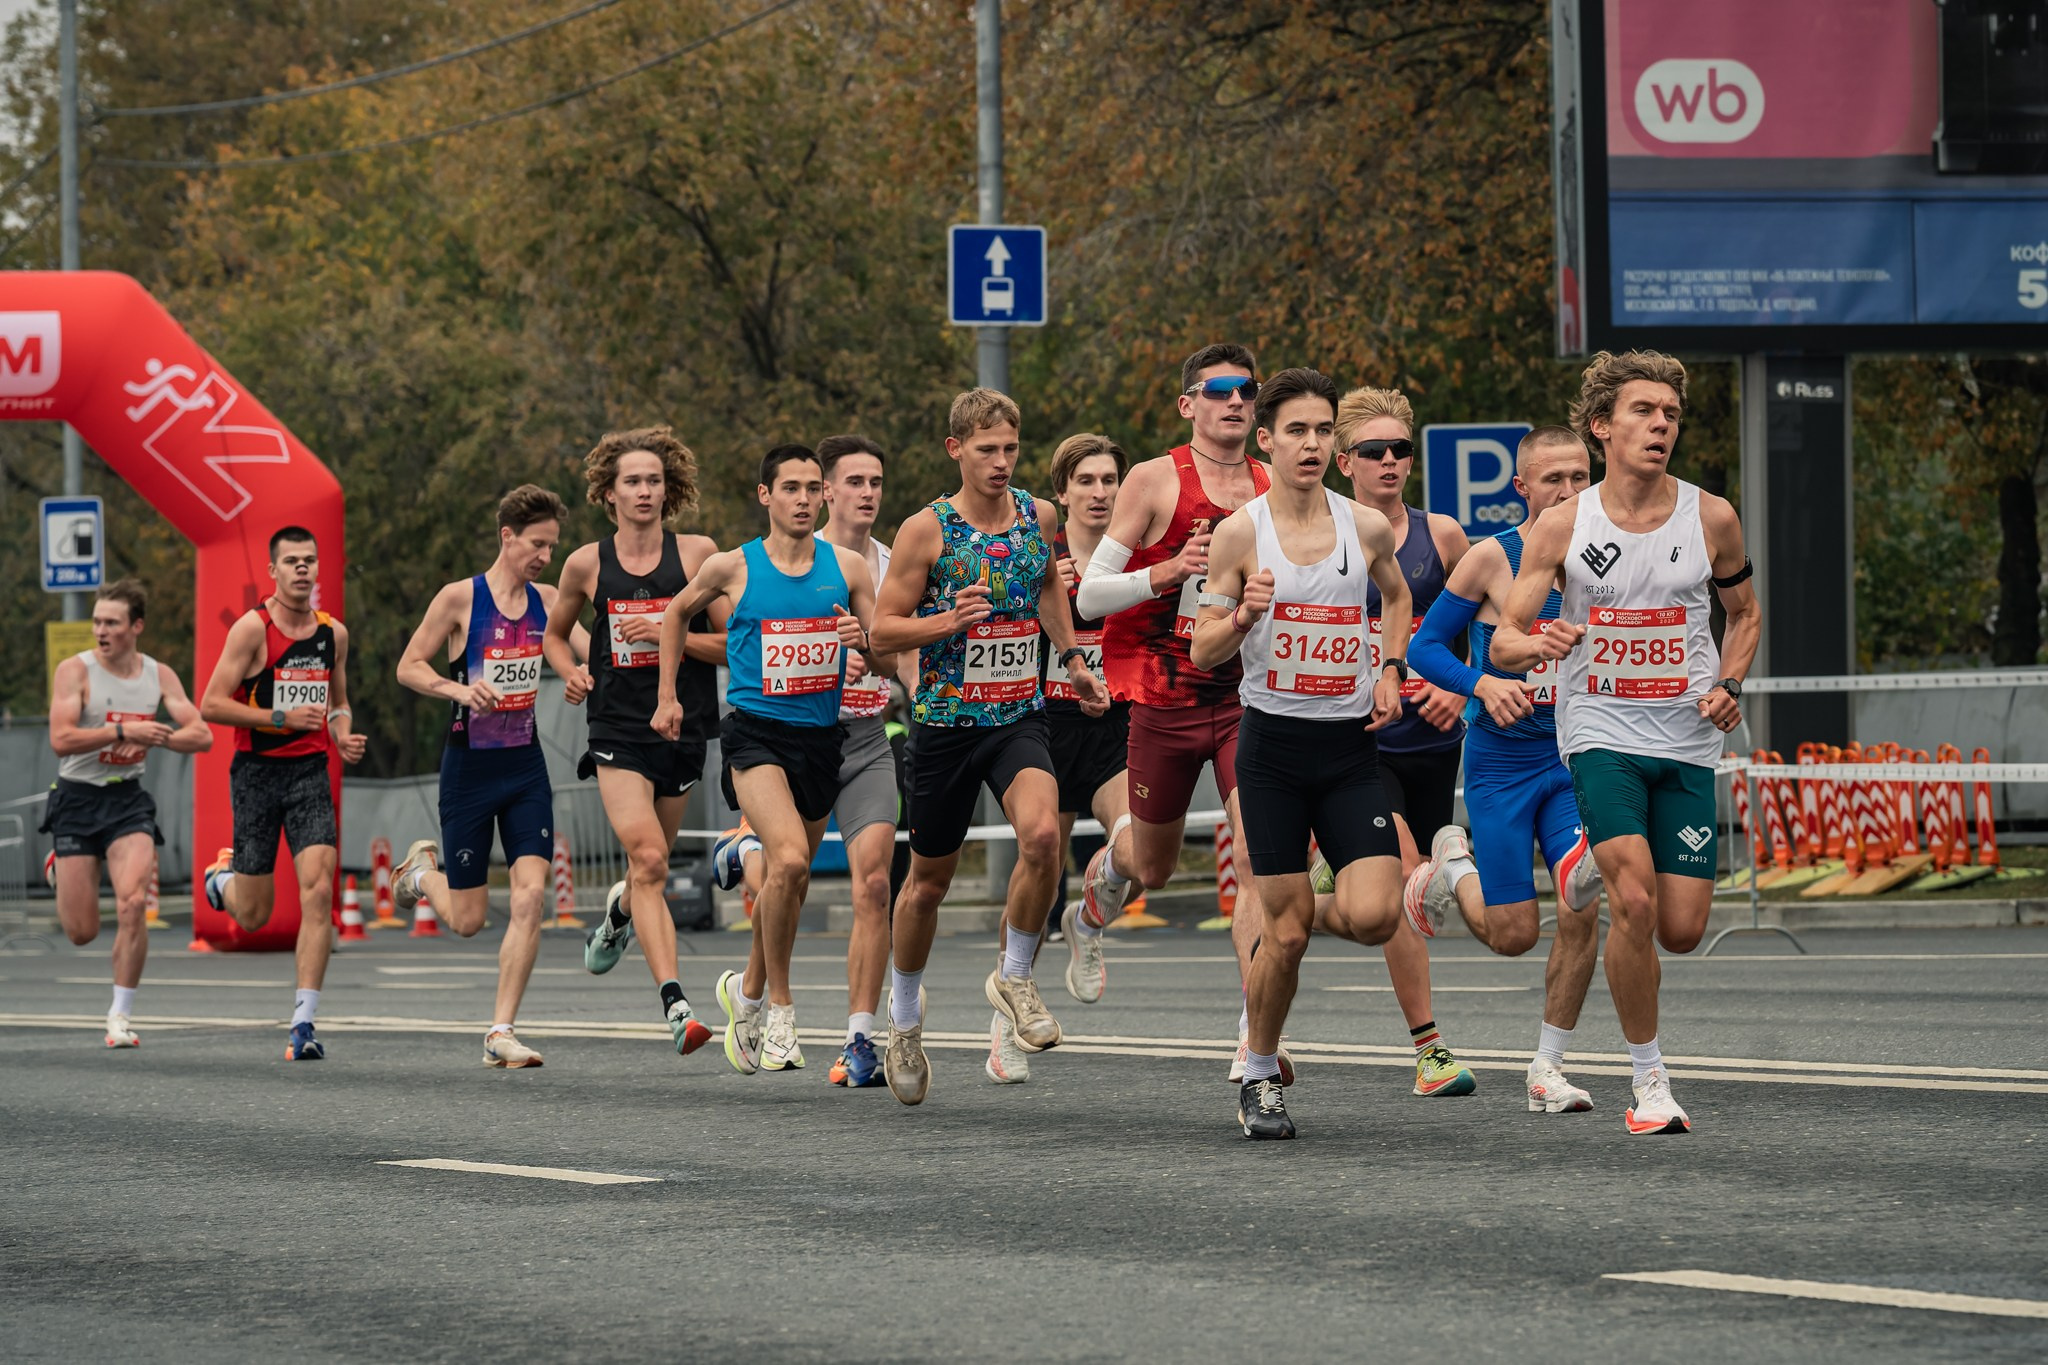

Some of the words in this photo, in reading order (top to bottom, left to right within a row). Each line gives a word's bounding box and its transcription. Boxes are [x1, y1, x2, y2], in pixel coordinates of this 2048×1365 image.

[1651, 67, 1747, 124] wb
[2017, 269, 2048, 309] 5
[1456, 439, 1514, 526] P
[1596, 585, 1615, 595] 2012
[766, 641, 839, 668] 29837
[968, 638, 1035, 669] 21531
[1274, 632, 1361, 664] 31482
[1593, 637, 1685, 666] 29585
[620, 652, 630, 664] A
[493, 660, 537, 683] 2566
[990, 669, 1022, 678] КИРИЛЛ
[502, 682, 531, 692] НИКОЛАЙ
[774, 678, 785, 691] A
[969, 685, 983, 700] A
[1537, 686, 1549, 700] A
[1600, 677, 1613, 692] A
[277, 684, 327, 704] 19908
[1690, 855, 1708, 864] 2012
